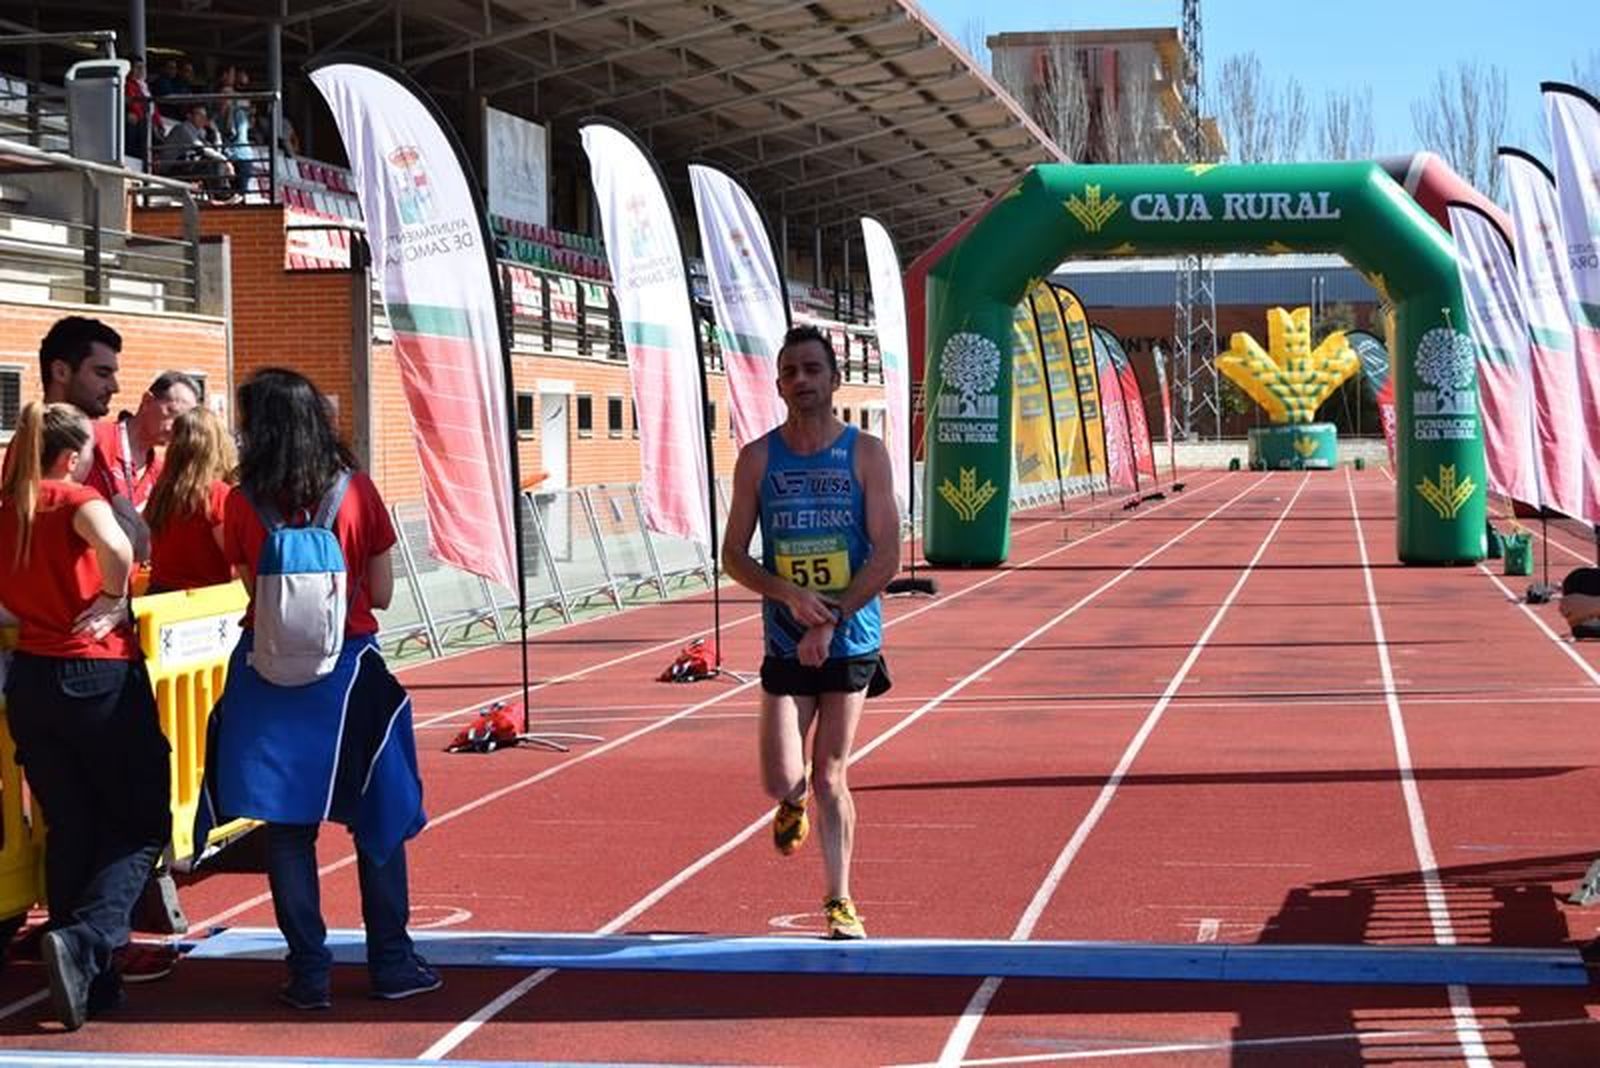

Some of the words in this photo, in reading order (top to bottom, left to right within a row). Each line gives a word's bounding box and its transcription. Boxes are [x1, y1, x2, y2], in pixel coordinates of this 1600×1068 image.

[1130, 192, 1213, 222] CAJA
[1222, 191, 1341, 220] RURAL
[771, 510, 854, 529] ATLETISMO
[791, 558, 831, 587] 55
